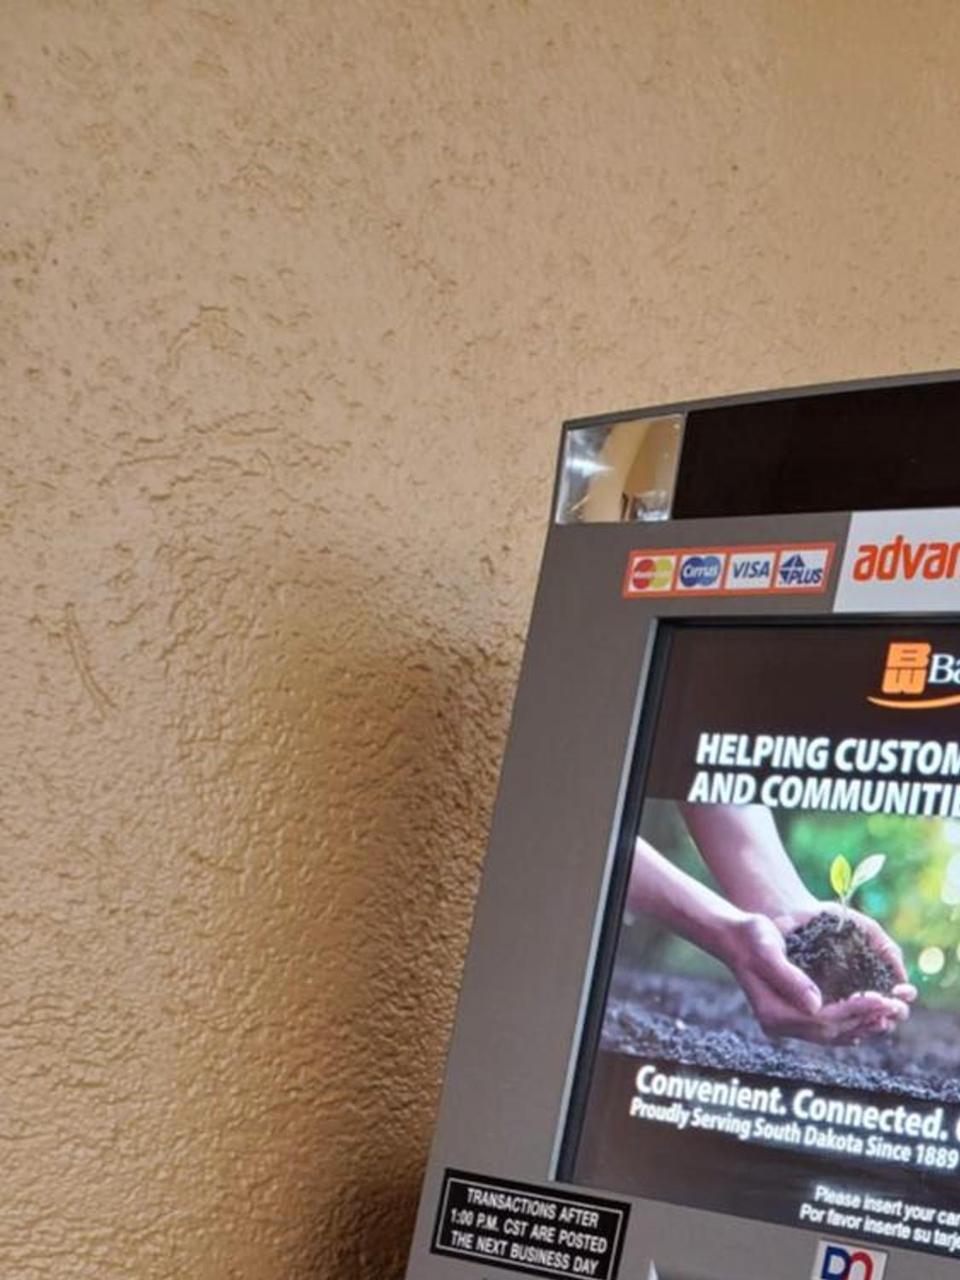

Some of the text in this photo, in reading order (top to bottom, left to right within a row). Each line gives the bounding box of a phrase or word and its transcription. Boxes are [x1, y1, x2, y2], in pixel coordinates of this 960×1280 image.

[732, 560, 771, 581] VISA
[788, 567, 823, 585] PLUS
[696, 732, 830, 771] HELPING
[687, 771, 756, 804] AND
[635, 1065, 787, 1116] Convenient.
[793, 1088, 949, 1142] Connected.
[629, 1097, 960, 1170] Proudly Serving South Dakota Since 1889
[467, 1188, 600, 1229] TRANSACTIONS AFTER
[800, 1203, 825, 1223] Por
[826, 1208, 864, 1230] favor
[863, 1215, 911, 1240] inserte
[913, 1228, 932, 1244] su
[814, 1184, 862, 1209] Please
[863, 1194, 904, 1216] insert
[903, 1203, 937, 1223] your
[451, 1208, 608, 1255] 1:00 P.M. CST ARE POSTED
[451, 1231, 600, 1276] THE NEXT BUSINESS DAY
